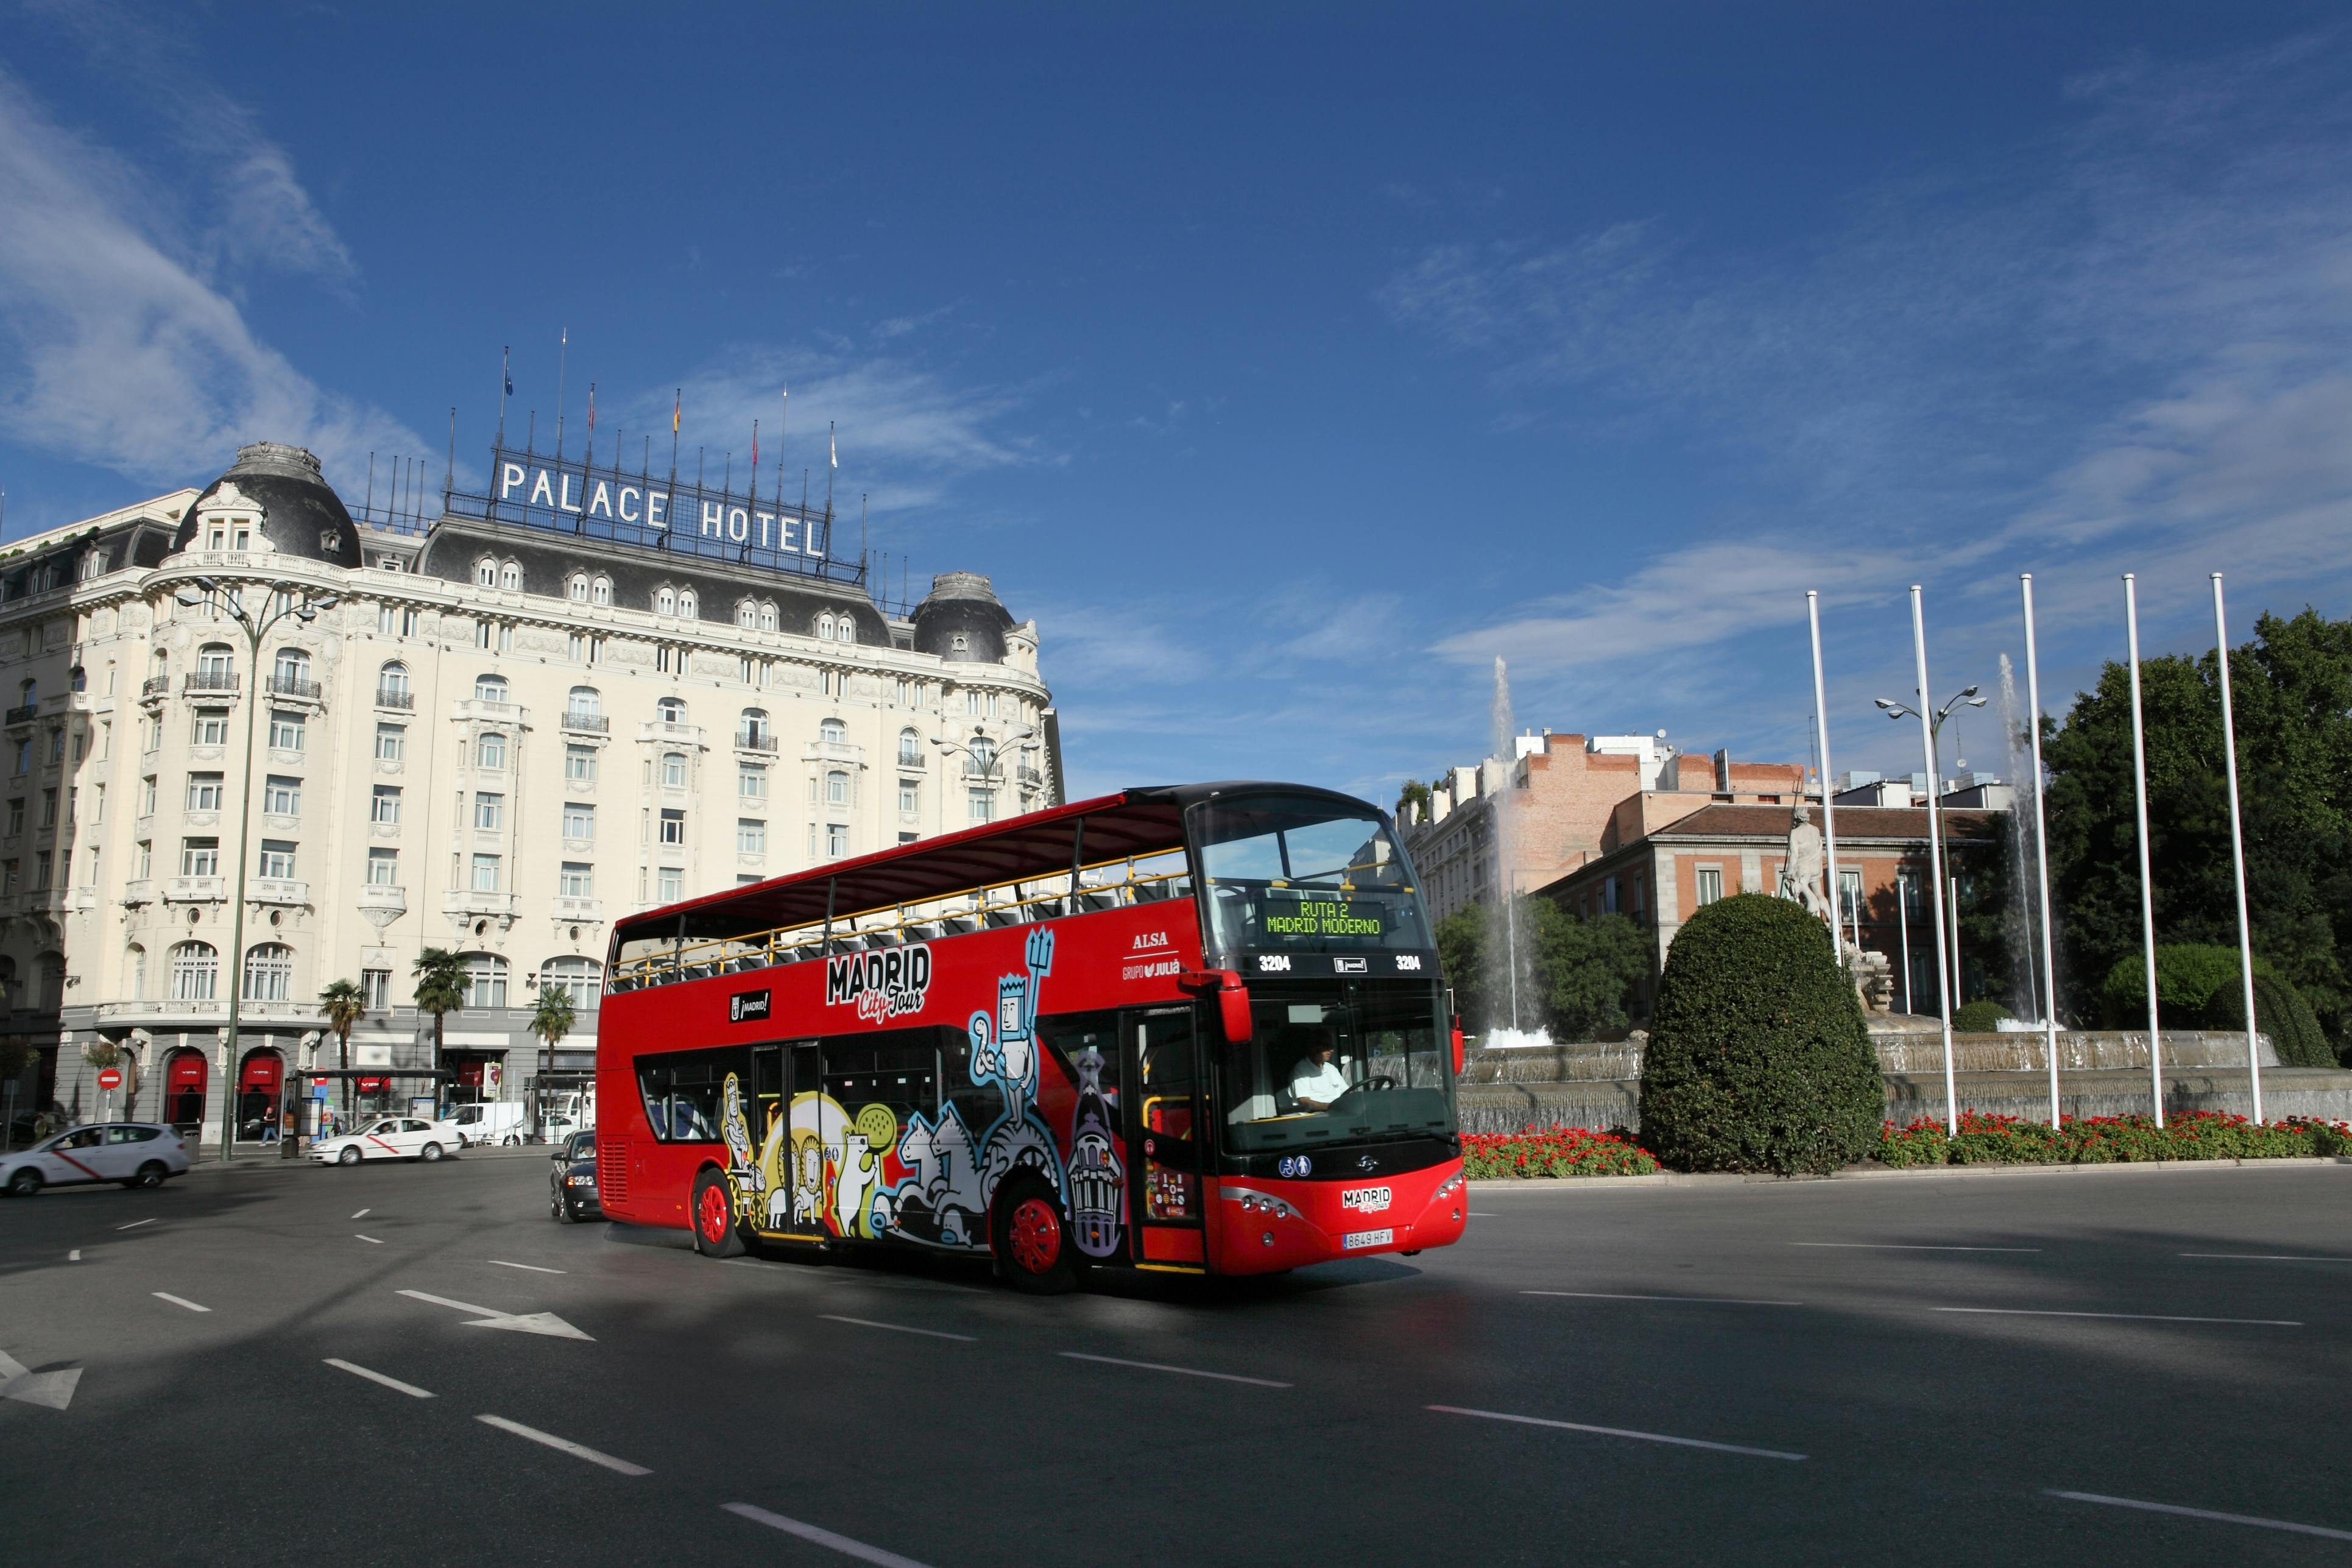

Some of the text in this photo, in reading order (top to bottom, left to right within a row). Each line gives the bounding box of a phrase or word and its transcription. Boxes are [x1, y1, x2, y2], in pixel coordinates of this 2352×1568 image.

[502, 463, 824, 557] PALACE HOTEL
[1301, 902, 1349, 917] RUTA 2
[1267, 917, 1380, 934] MADRID MODERNO
[1132, 931, 1168, 949] ALSA
[1259, 955, 1291, 971] 3204
[1396, 955, 1421, 970] 3204
[827, 946, 930, 1003] MADRID
[1123, 965, 1143, 980] GRUPO
[741, 992, 768, 1019] ¡MADRID!
[860, 984, 923, 1021] City Tour
[1344, 1188, 1390, 1207] MADRID
[1349, 1231, 1391, 1247] 8649 HFV
